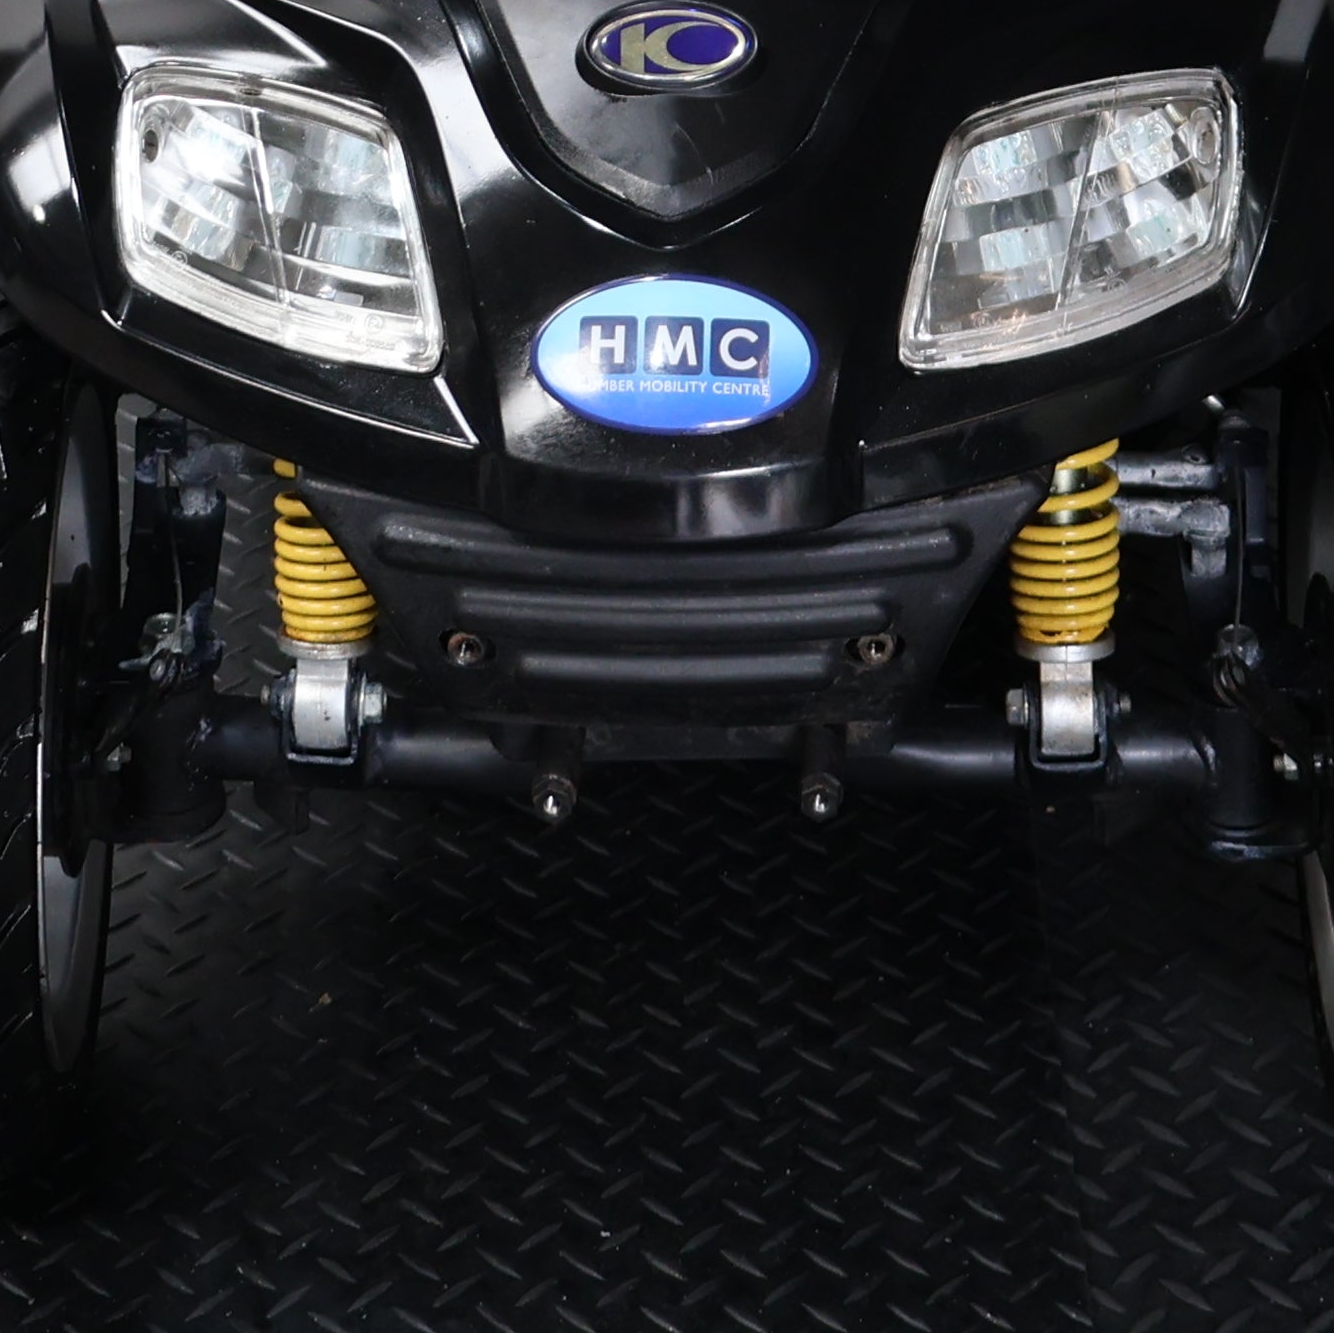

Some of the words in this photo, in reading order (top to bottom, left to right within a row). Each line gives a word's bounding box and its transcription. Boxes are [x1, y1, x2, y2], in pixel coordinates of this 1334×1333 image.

[589, 325, 759, 371] HMC
[639, 379, 708, 394] MOBILITY
[712, 381, 770, 397] CENTRE
